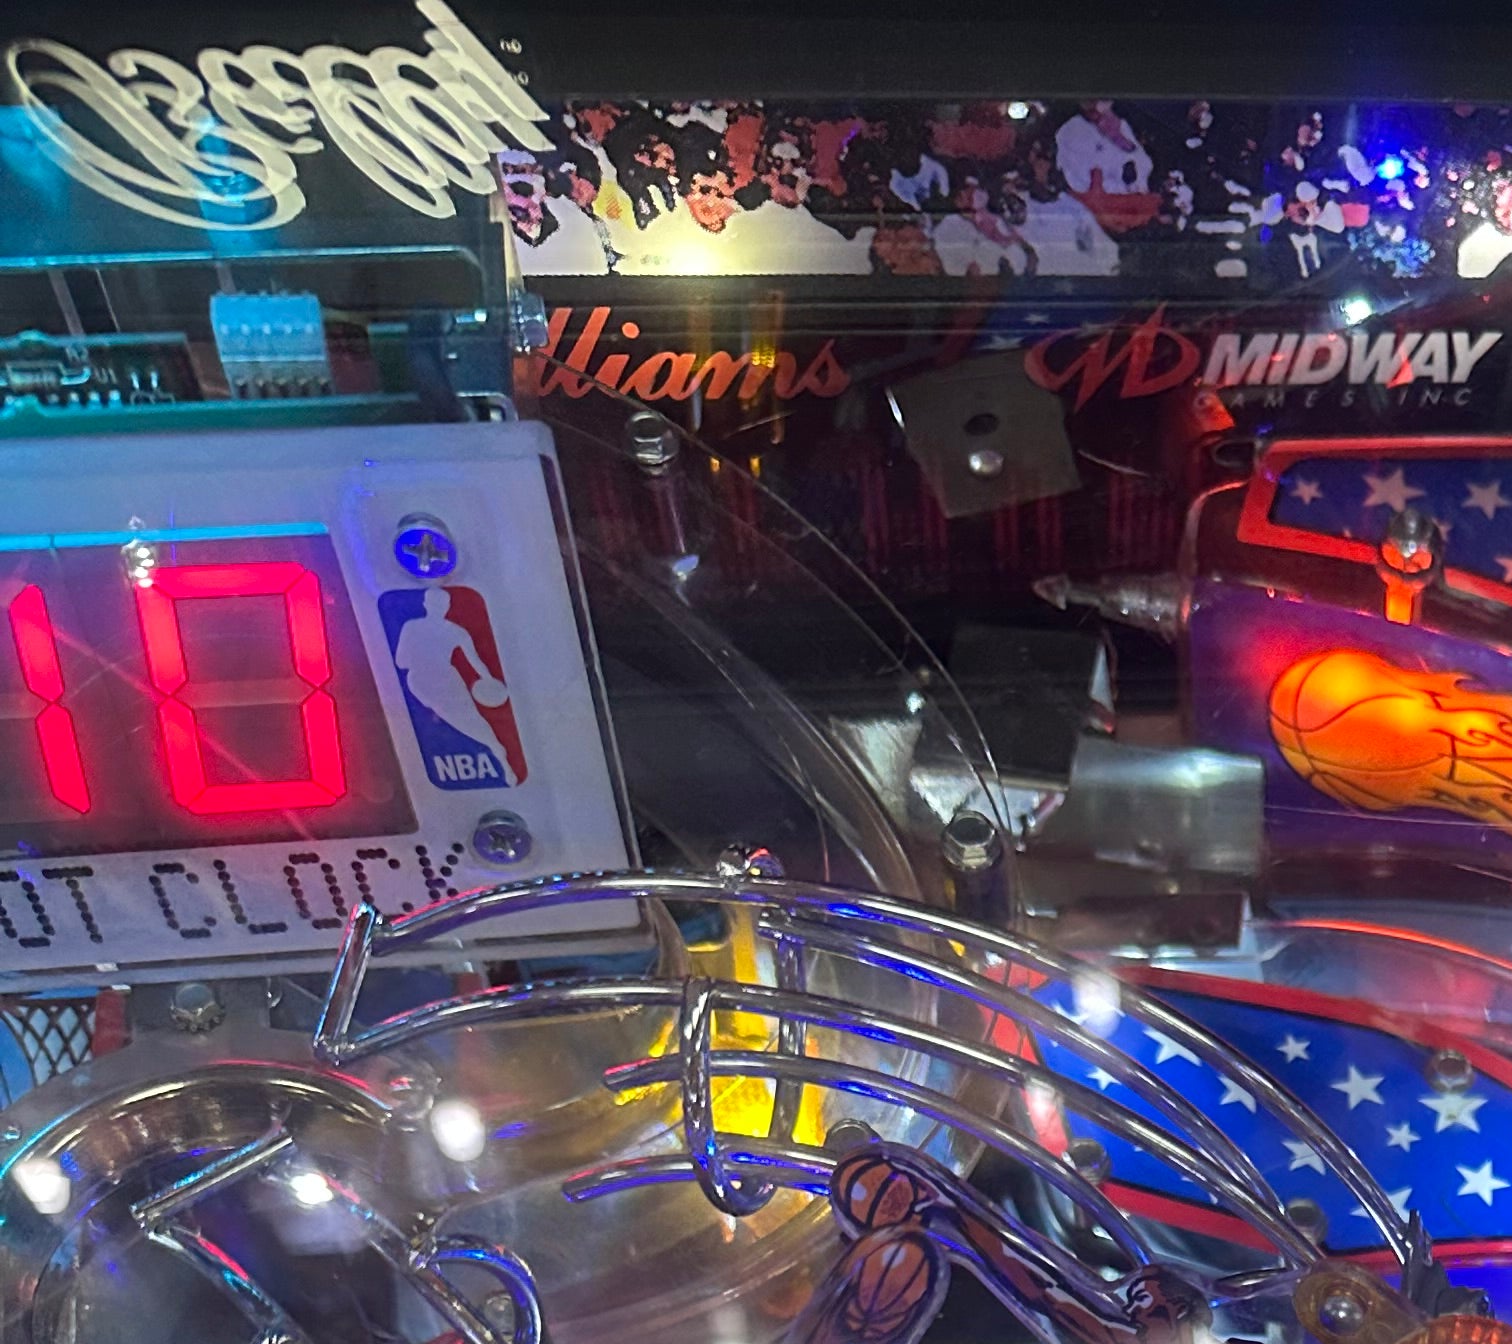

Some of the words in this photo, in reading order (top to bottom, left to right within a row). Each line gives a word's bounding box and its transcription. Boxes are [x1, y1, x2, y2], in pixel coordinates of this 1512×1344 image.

[1201, 331, 1504, 385] MIDWAY
[8, 562, 347, 816] 10
[433, 752, 499, 782] NBA
[149, 842, 466, 939] CLOCK
